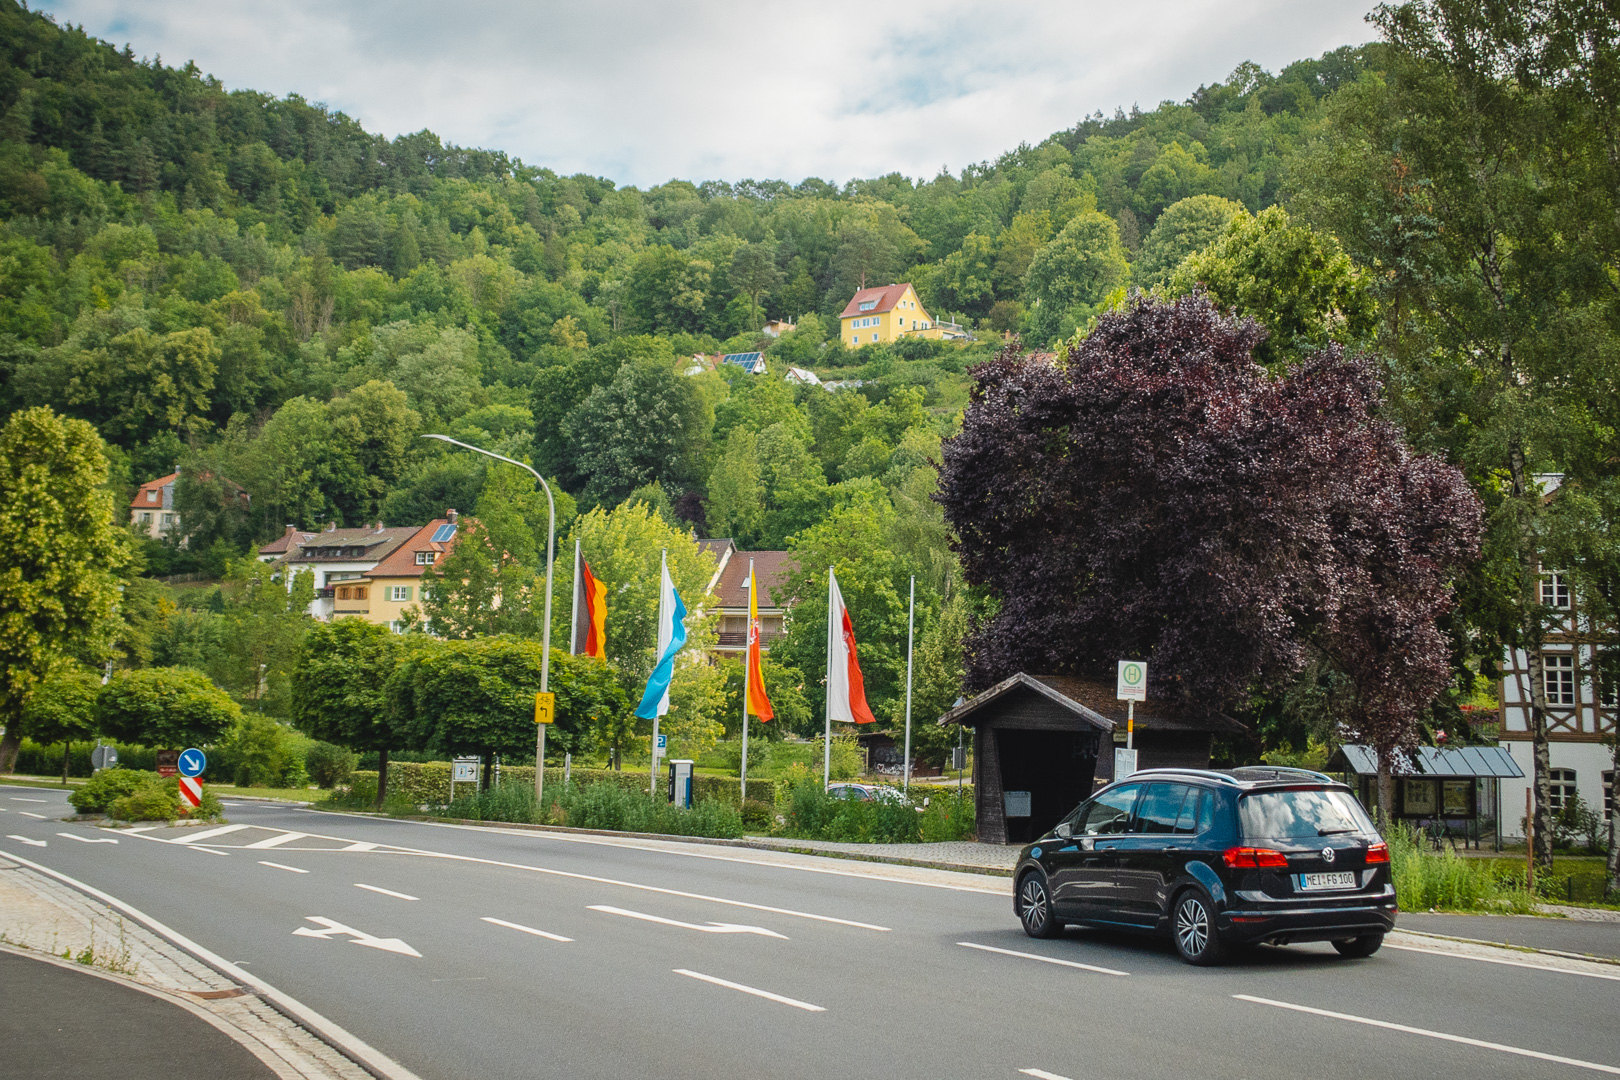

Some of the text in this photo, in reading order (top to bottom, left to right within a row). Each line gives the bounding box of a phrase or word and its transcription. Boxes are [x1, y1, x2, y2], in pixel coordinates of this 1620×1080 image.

[1128, 667, 1137, 681] H
[1306, 873, 1354, 886] MEI FG 100
